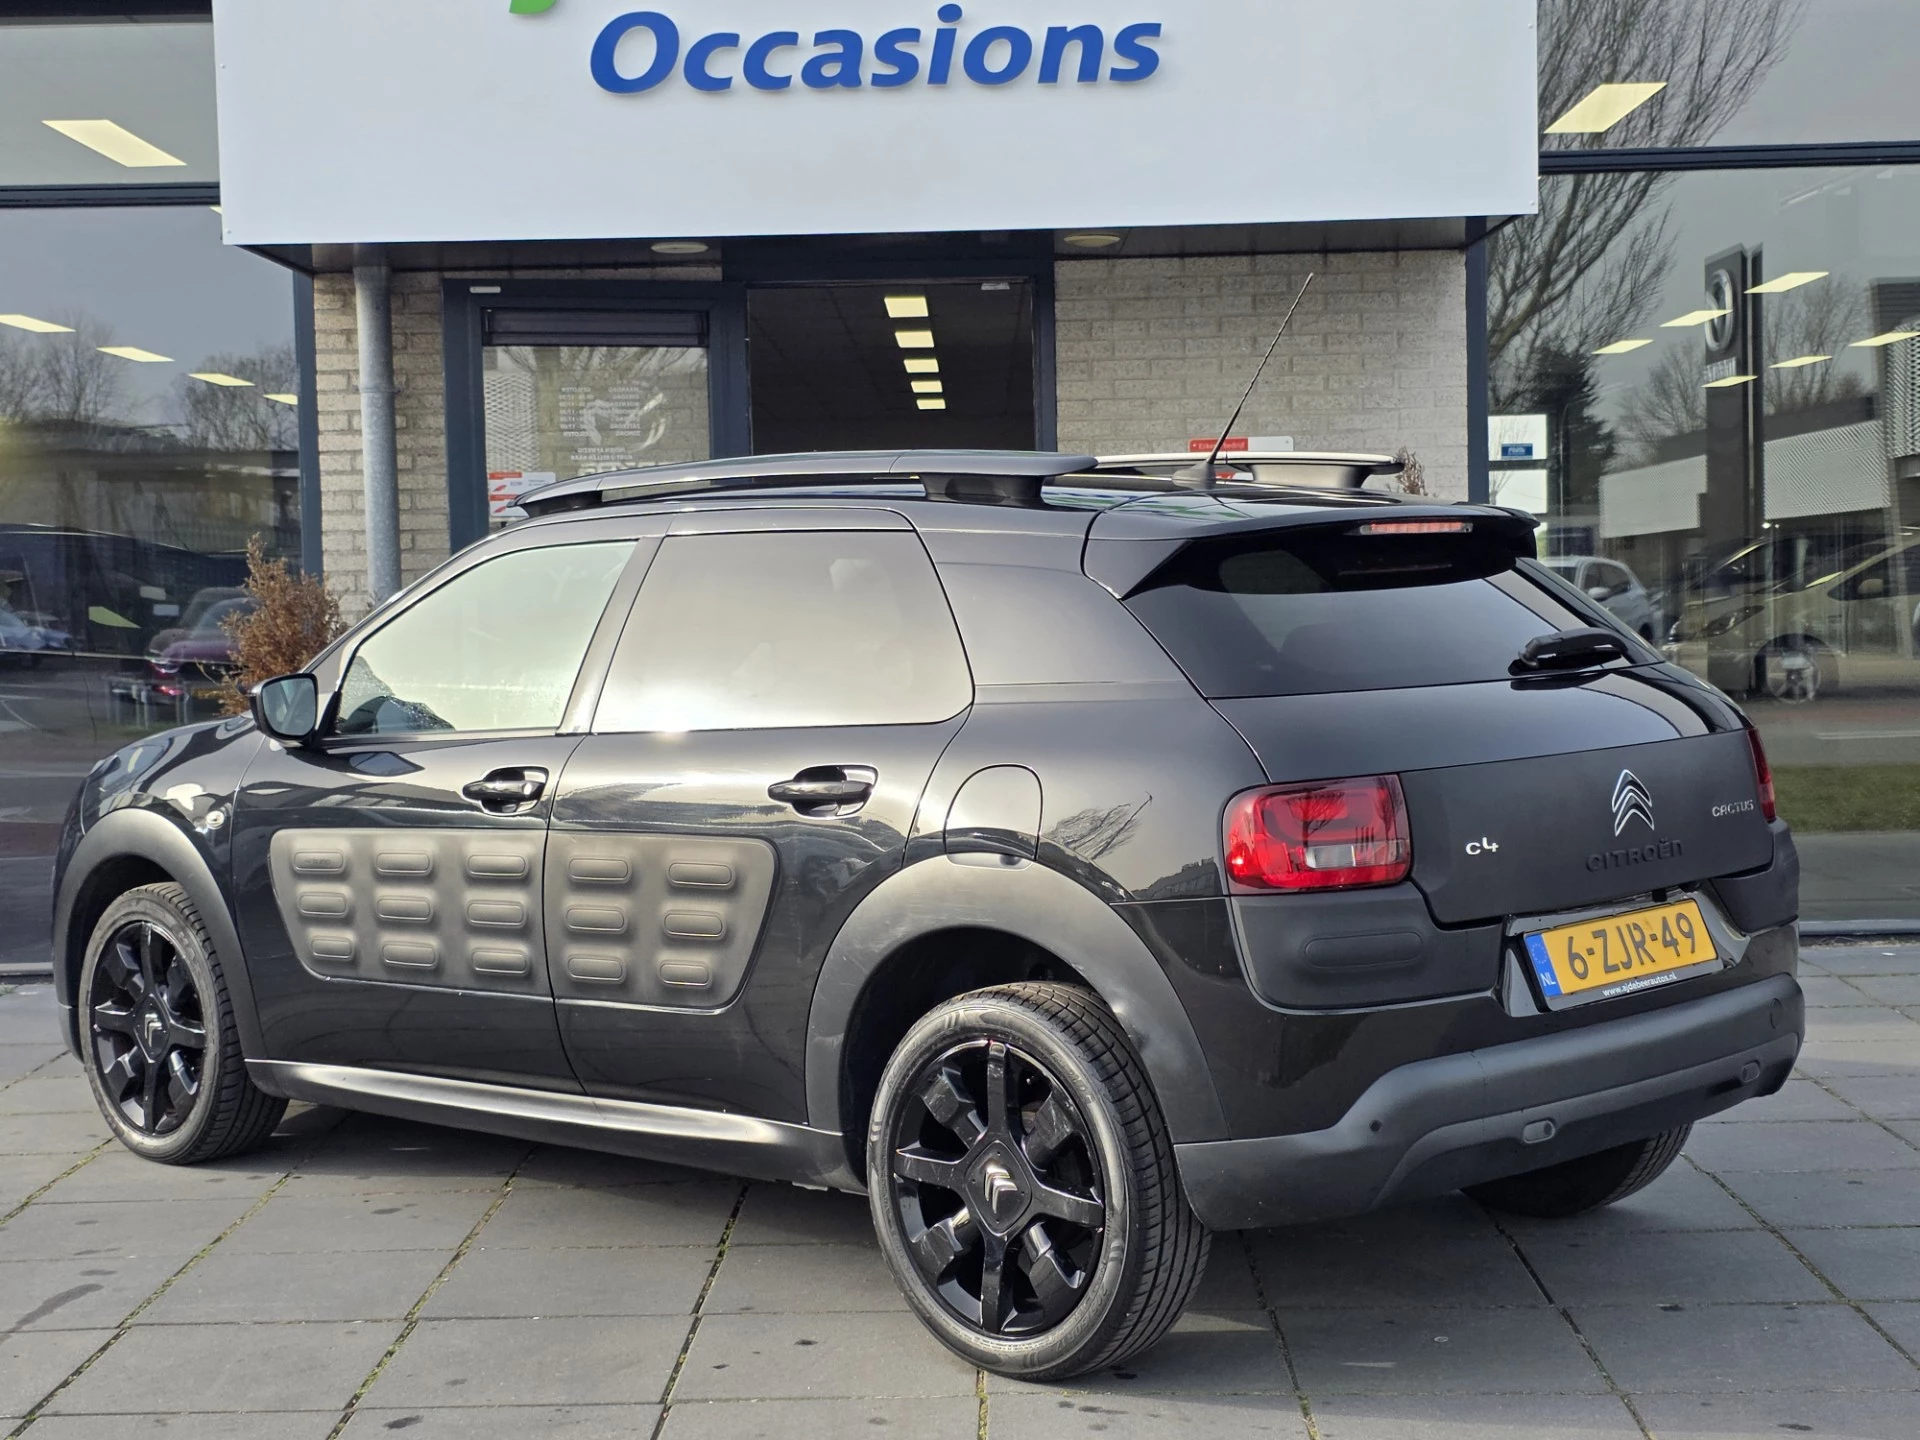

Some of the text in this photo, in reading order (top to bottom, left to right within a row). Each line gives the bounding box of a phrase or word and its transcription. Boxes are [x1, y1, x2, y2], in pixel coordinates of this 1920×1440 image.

[589, 3, 1162, 95] Occasions
[1711, 799, 1754, 818] CACTUS
[1567, 912, 1696, 980] 6-ZJR-49
[1540, 971, 1557, 987] NL
[1602, 972, 1678, 997] www.ajdebeerautos.nl
